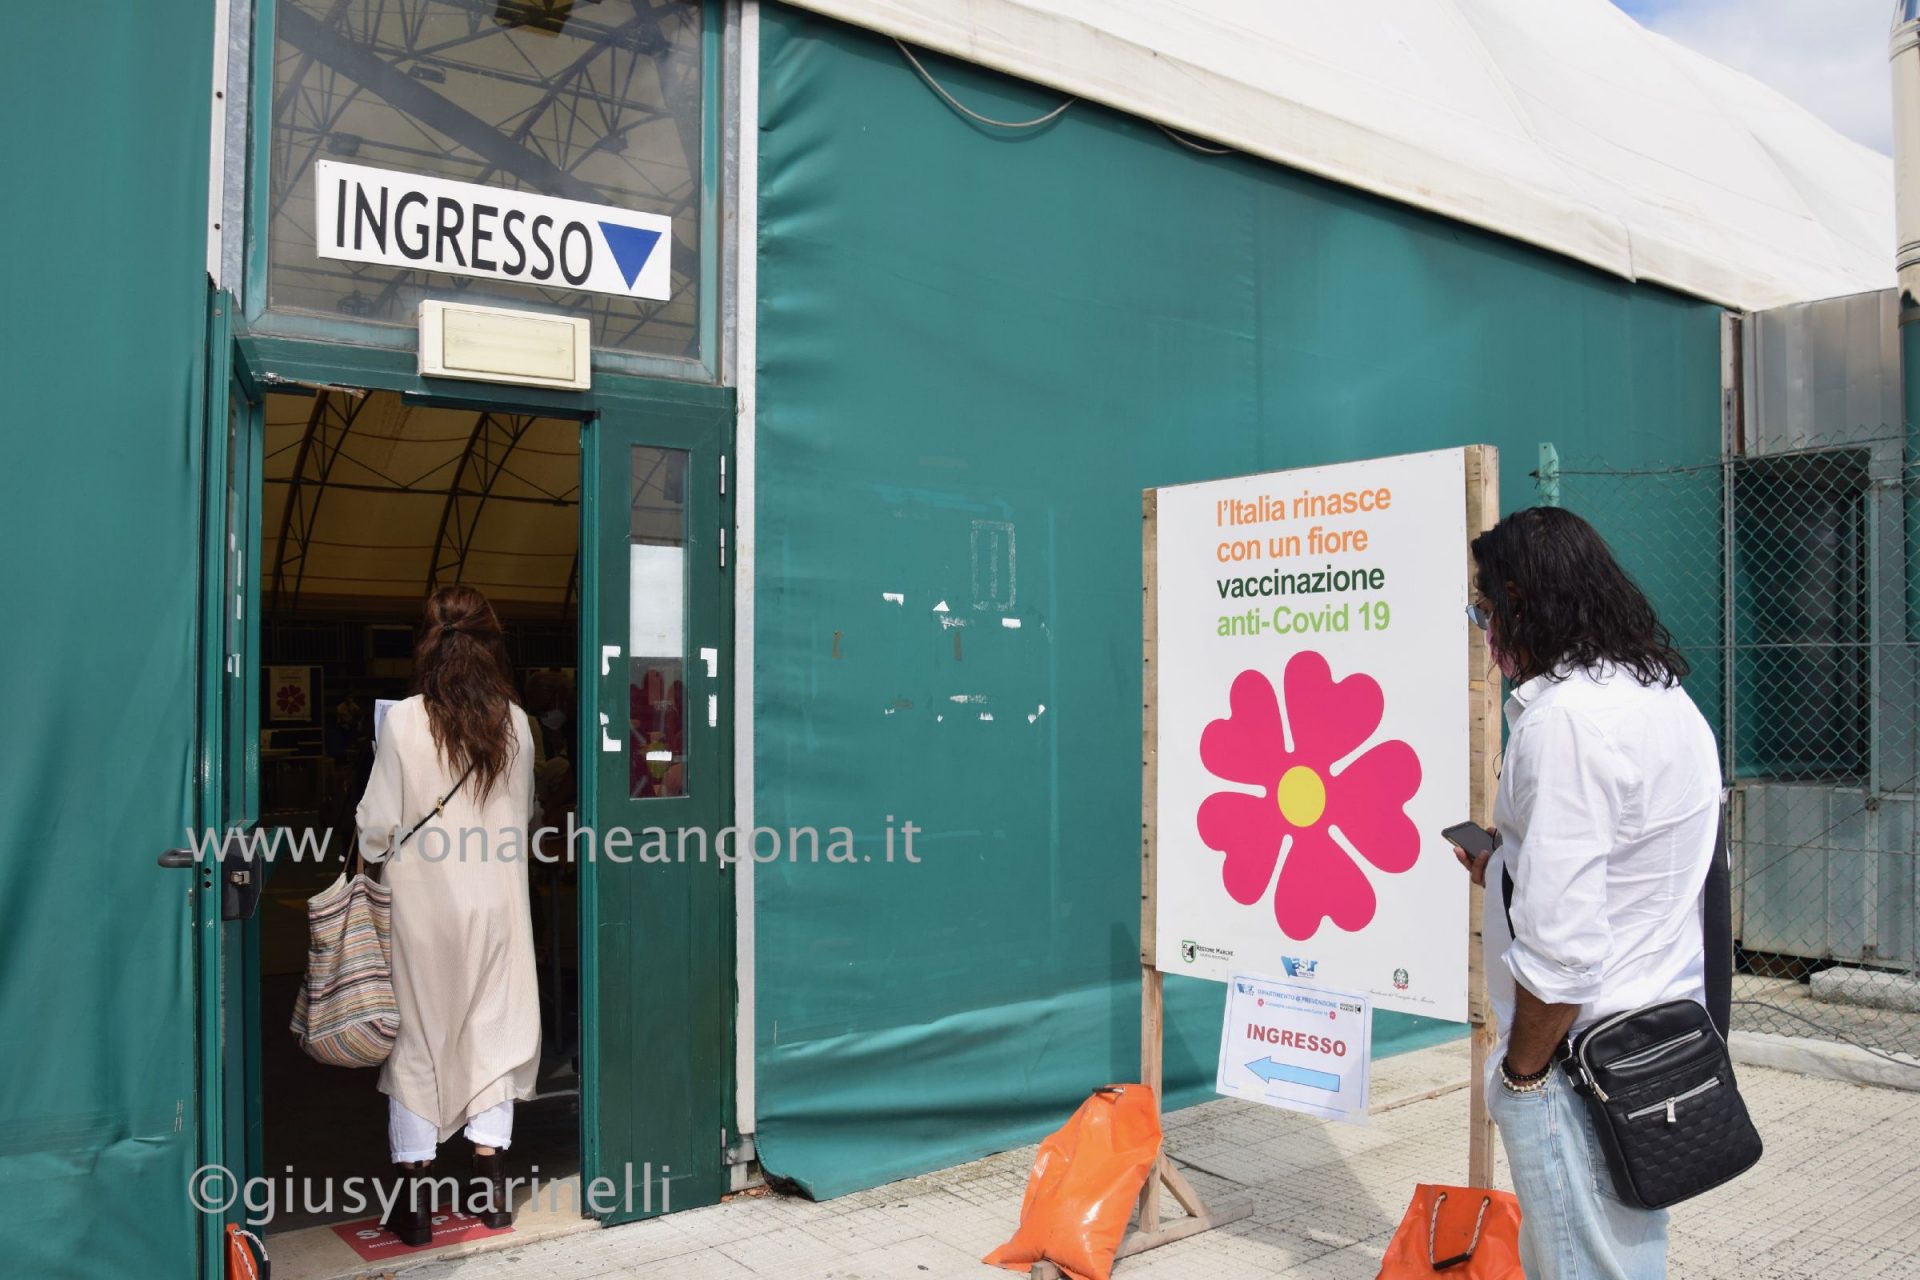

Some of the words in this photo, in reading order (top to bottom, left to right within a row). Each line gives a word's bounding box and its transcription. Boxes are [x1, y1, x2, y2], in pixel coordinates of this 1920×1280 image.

[336, 178, 594, 287] INGRESSO
[1216, 494, 1286, 527] l'Italia
[1292, 486, 1392, 519] rinasce
[1216, 538, 1262, 563] con
[1268, 535, 1301, 559] un
[1307, 525, 1369, 555] fiore
[1216, 563, 1385, 599] vaccinazione
[1216, 602, 1349, 637] anti-Covid
[1358, 600, 1391, 631] 19
[1246, 1023, 1347, 1057] INGRESSO
